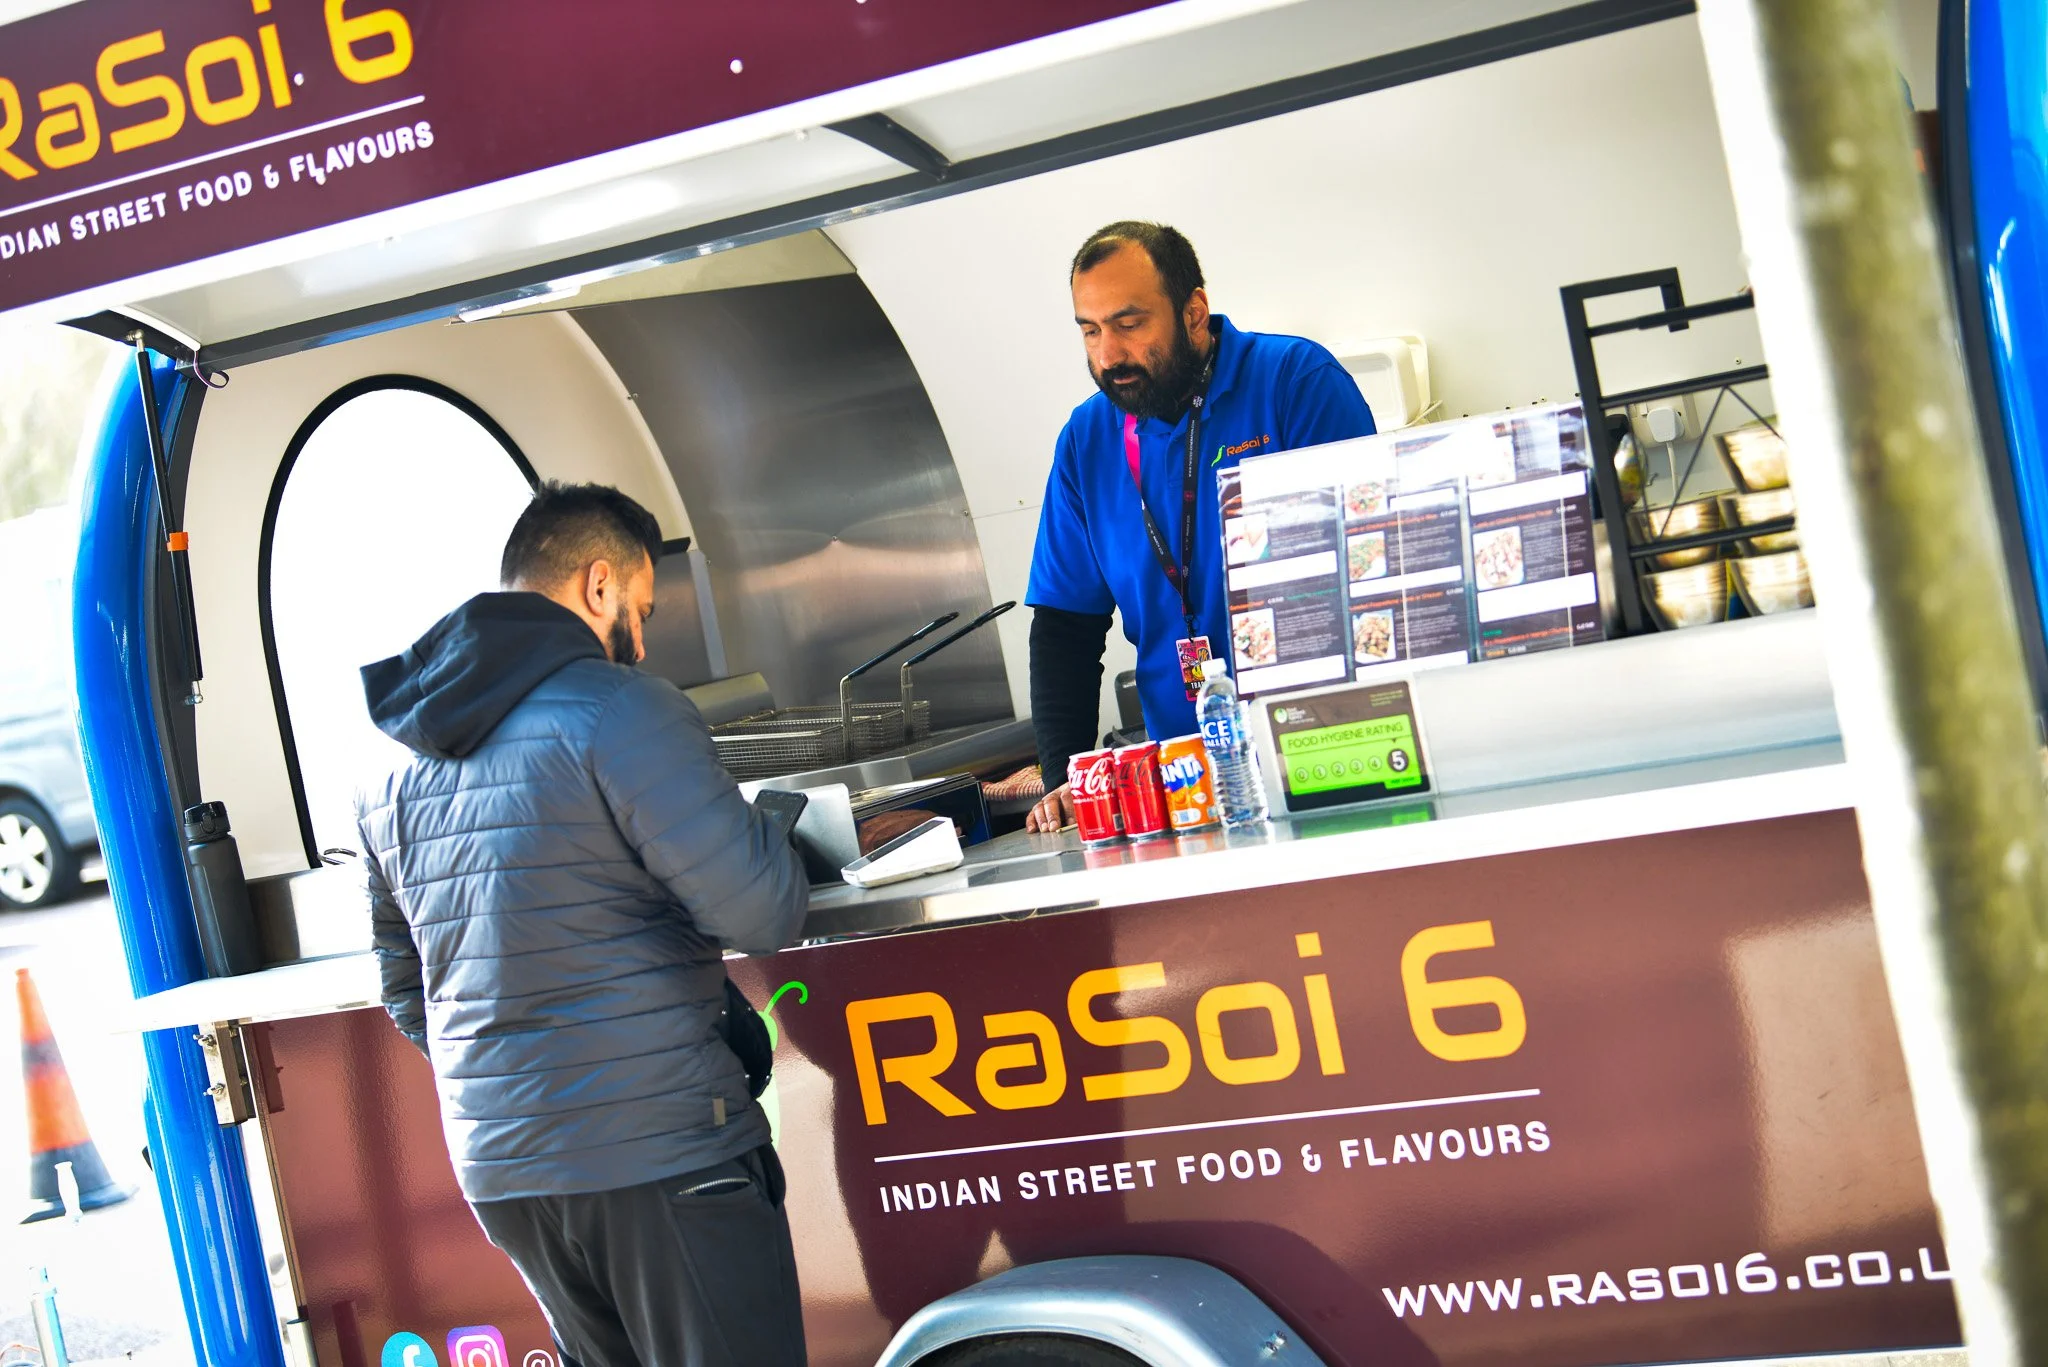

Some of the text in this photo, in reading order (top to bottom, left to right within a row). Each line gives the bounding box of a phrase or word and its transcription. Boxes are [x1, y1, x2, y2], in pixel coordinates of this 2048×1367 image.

[323, 0, 413, 84] 6
[0, 121, 434, 259] DIAN STREET FOOD & FLAVOURS
[1226, 434, 1271, 456] RaSoi 6
[1200, 719, 1231, 740] ICE
[1287, 722, 1403, 749] FOOD HYGIENE RATING
[1160, 753, 1204, 783] ANTA
[1391, 750, 1406, 771] 5
[845, 920, 1527, 1126] RaSoi 6
[880, 1120, 1551, 1213] INDIAN STREET FOOD & FLAVOURS
